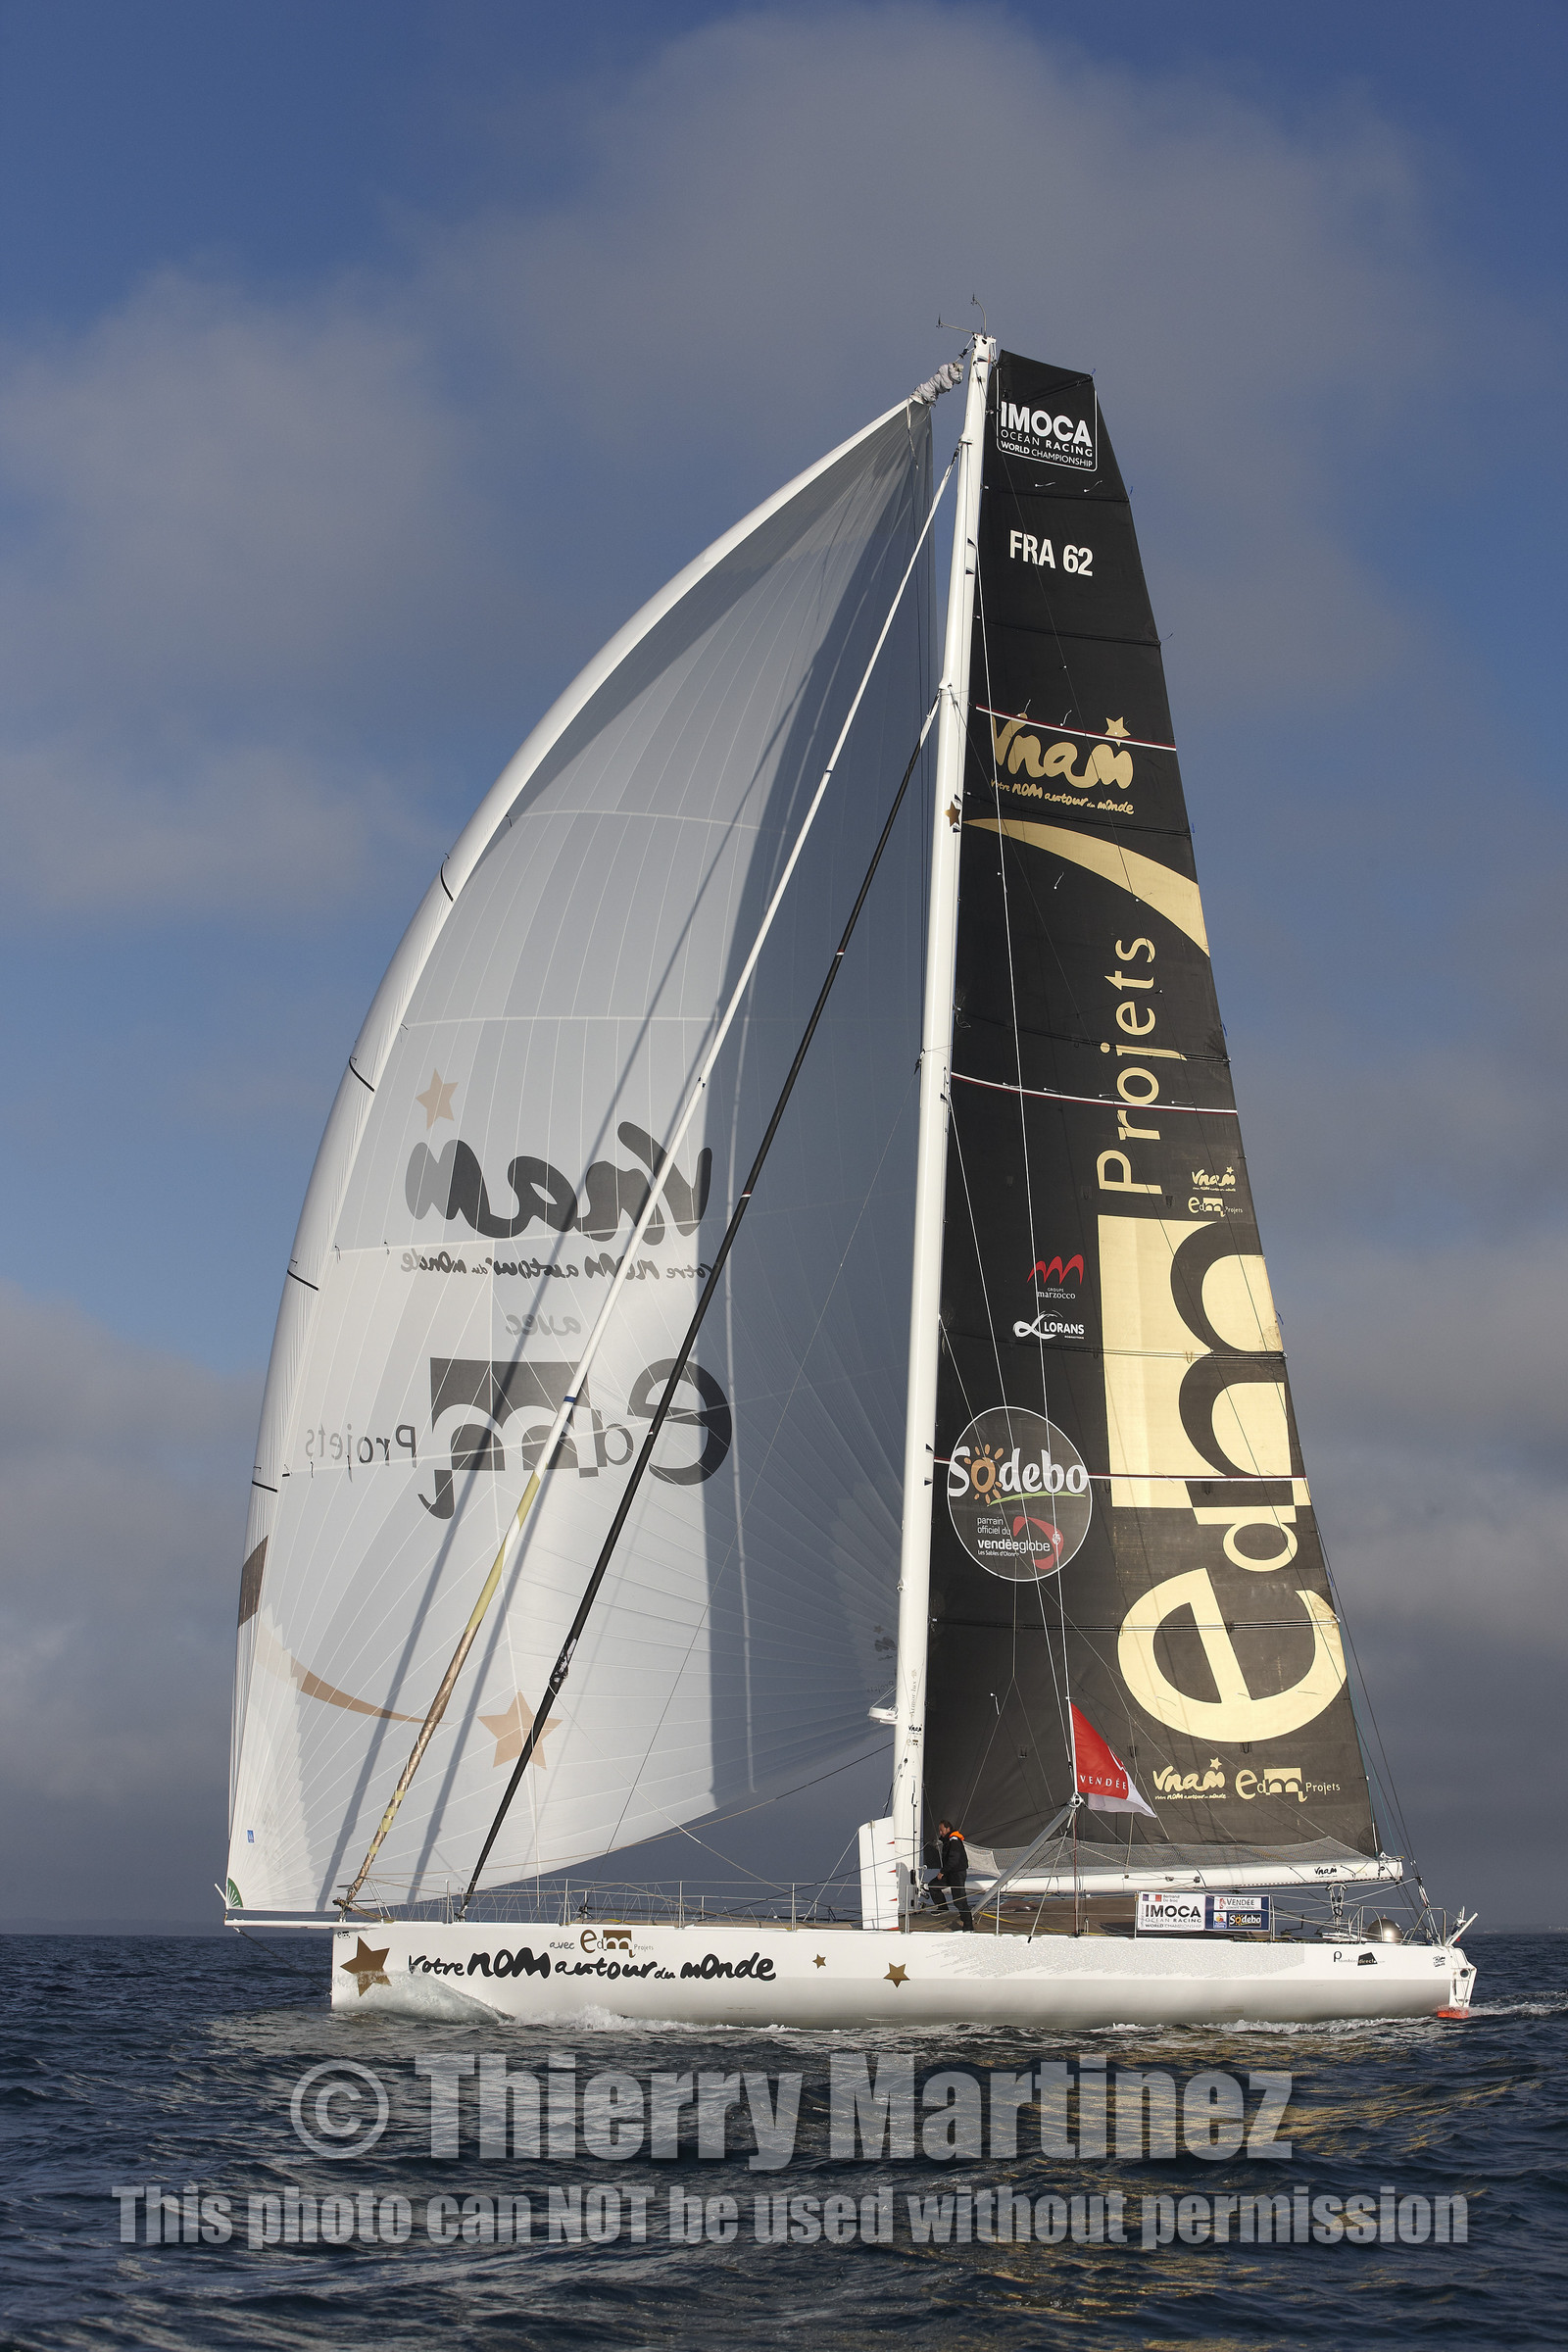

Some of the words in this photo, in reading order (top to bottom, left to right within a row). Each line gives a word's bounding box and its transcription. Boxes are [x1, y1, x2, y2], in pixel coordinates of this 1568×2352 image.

[1001, 401, 1093, 448] IMOCA
[1001, 429, 1040, 446] OCEAN
[1046, 440, 1093, 458] RACING
[1001, 440, 1030, 455] WORLD
[1031, 448, 1093, 467] CHAMPIONSHIP
[1009, 529, 1055, 568] FRA
[1062, 544, 1095, 576] 62
[1096, 937, 1188, 1195] Projets
[1037, 1291, 1076, 1299] marzocco
[1044, 1321, 1085, 1335] LORANS
[948, 1446, 1089, 1497] Sodebo
[977, 1525, 1001, 1535] officiel
[1079, 1774, 1127, 1790] VENDÉE
[1305, 1782, 1341, 1795] Projets
[1226, 1897, 1255, 1906] VENDÉE
[1145, 1904, 1201, 1918] IMOCA
[1229, 1913, 1261, 1926] Sodebo
[549, 1941, 575, 1950] avec
[555, 1957, 658, 1980] autour
